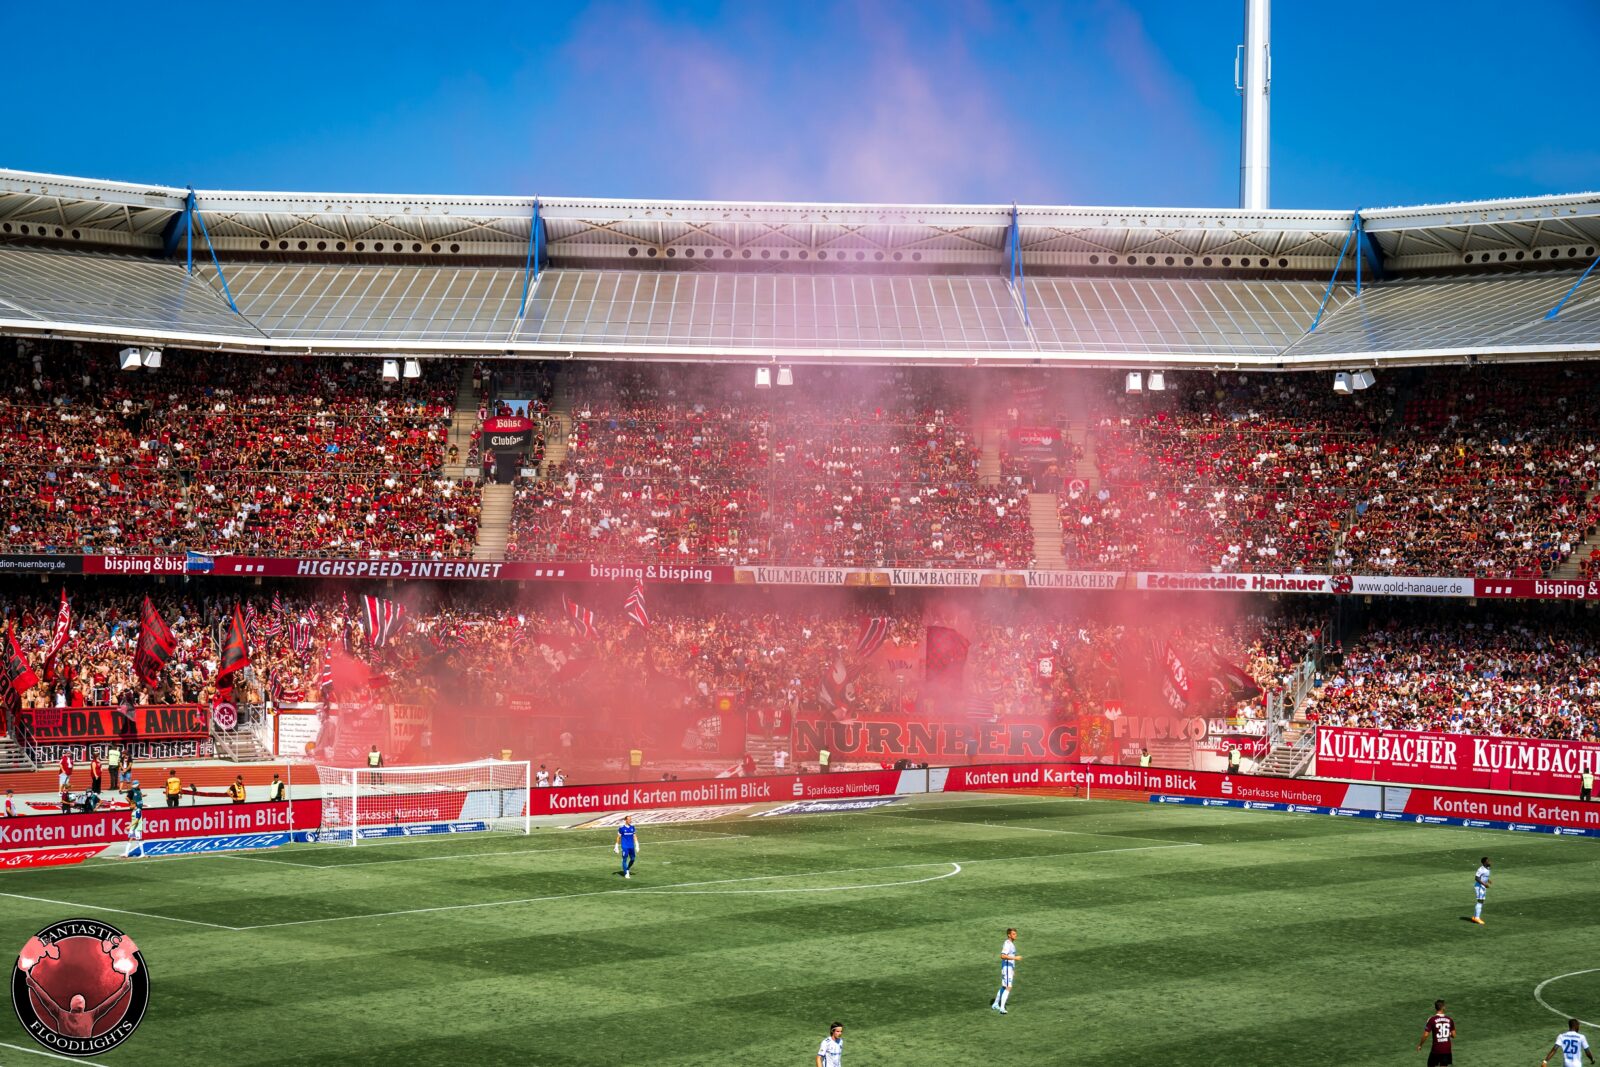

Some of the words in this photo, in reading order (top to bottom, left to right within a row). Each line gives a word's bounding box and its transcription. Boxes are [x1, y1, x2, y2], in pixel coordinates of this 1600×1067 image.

[104, 556, 151, 573] bisping
[153, 557, 163, 570] &
[297, 560, 502, 578] HIGHSPEED-INTERNET
[591, 564, 643, 580] bisping
[646, 565, 657, 578] &
[659, 565, 712, 582] bisping
[757, 567, 843, 584] KULMBACHER
[892, 569, 978, 586] KULMBACHER
[1028, 571, 1114, 588] KULMBACHER
[1252, 576, 1325, 591] Hanauer
[1358, 581, 1463, 594] www.gold-hanauer.de
[1535, 581, 1585, 598] bisping
[1587, 582, 1598, 595] &
[1318, 728, 1458, 766] KULMBACHER
[965, 771, 1008, 785] Konten
[1012, 768, 1039, 783] und
[1043, 768, 1096, 783] Karten
[1099, 770, 1142, 787] mobil
[1143, 771, 1162, 789] im
[1165, 774, 1197, 790] Blick
[550, 793, 599, 809] Konten
[603, 789, 629, 806] und
[633, 786, 677, 803] Karten
[680, 784, 718, 801] mobil
[720, 784, 738, 799] im
[741, 782, 771, 797] Blick
[807, 786, 845, 796] Sparkasse
[846, 783, 880, 795] Nürnberg
[1237, 785, 1279, 799] Sparkasse
[1281, 789, 1322, 804] Nürnberg
[1433, 795, 1488, 815] Konten
[1492, 799, 1523, 817] und
[1527, 803, 1580, 822] Karten
[0, 824, 65, 844] Konten
[71, 817, 105, 839] und
[111, 816, 170, 836] Katen
[175, 808, 224, 832] mobil
[228, 809, 251, 829] im
[256, 807, 295, 826] Blick
[1435, 1022, 1451, 1039] 36
[1562, 1039, 1579, 1055] 25
